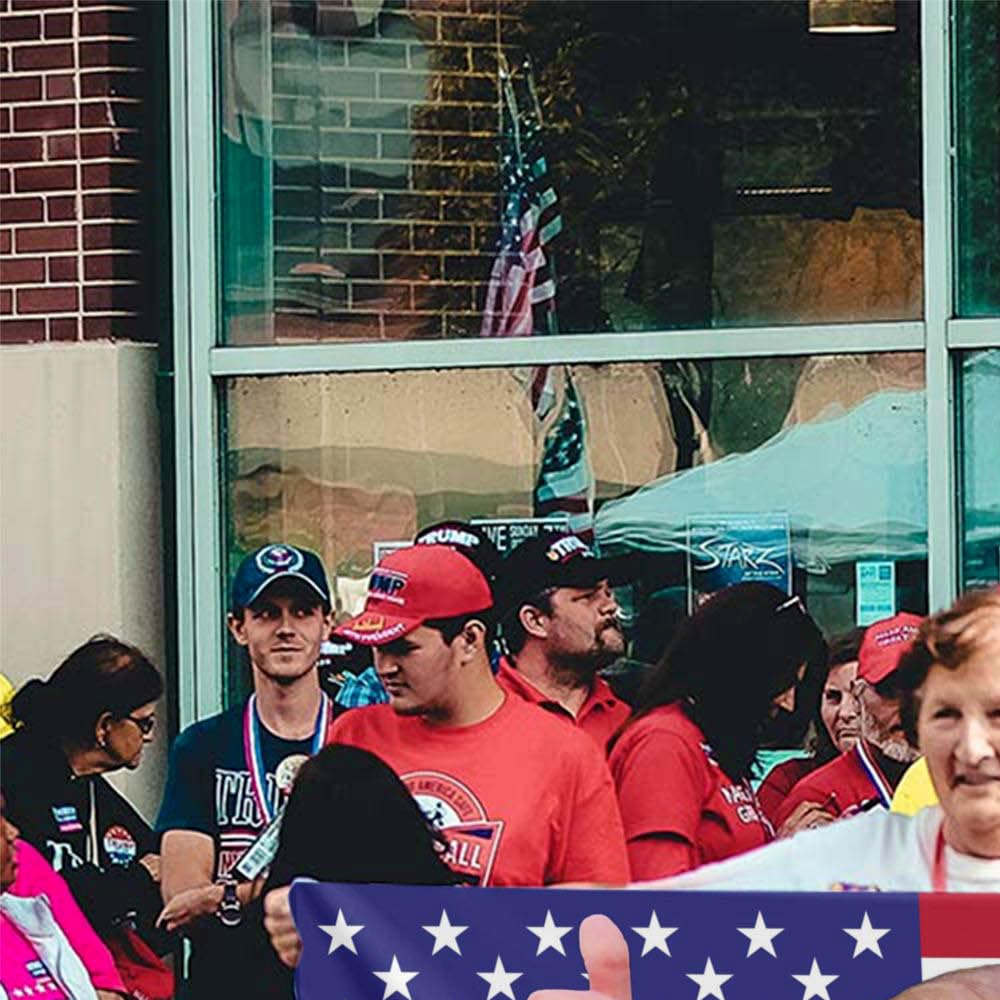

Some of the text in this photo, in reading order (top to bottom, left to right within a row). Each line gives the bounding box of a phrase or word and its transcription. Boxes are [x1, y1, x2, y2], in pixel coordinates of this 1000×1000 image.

[417, 528, 480, 548] TRUMP
[693, 536, 786, 575] STARZ
[442, 839, 482, 870] ALL
